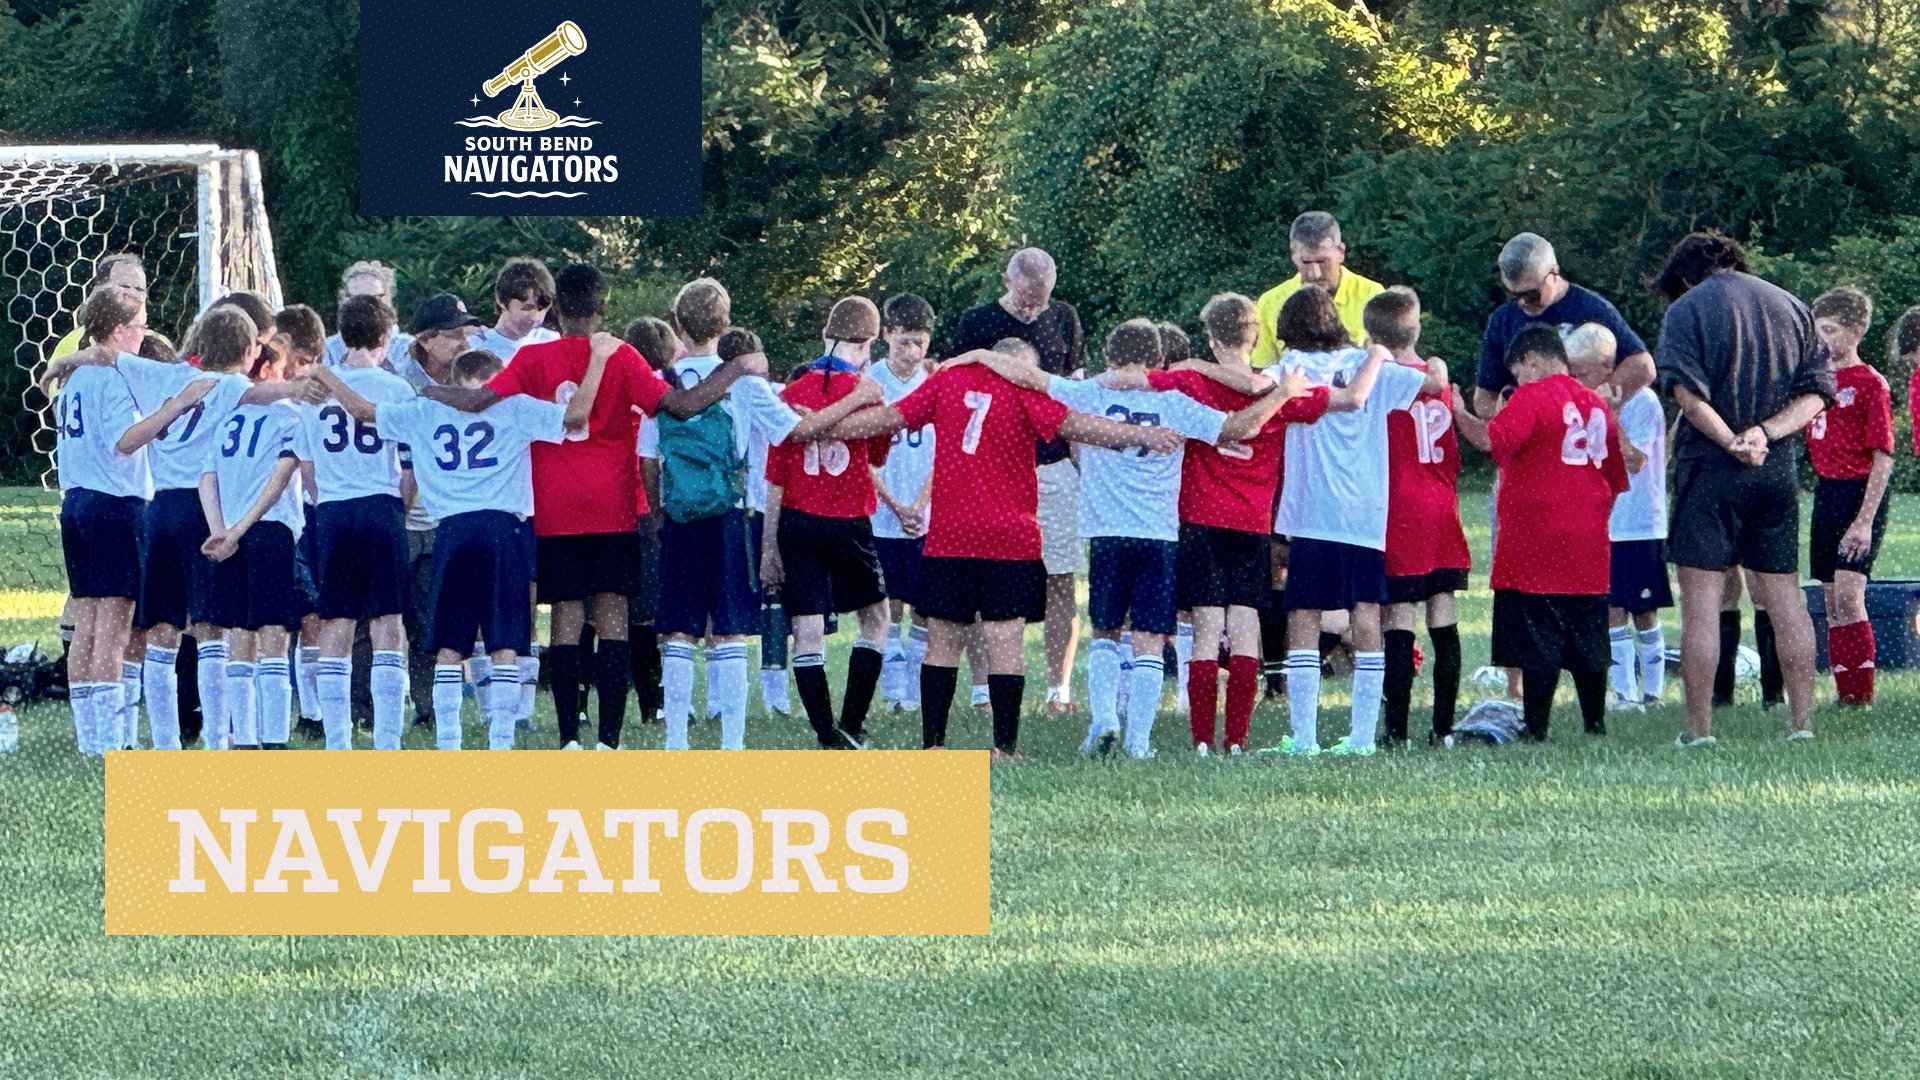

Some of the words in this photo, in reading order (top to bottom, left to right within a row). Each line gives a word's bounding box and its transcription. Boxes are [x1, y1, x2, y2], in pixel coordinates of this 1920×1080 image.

[221, 414, 268, 458] 31
[319, 406, 383, 454] 36
[433, 421, 498, 471] 32
[963, 391, 992, 455] 7
